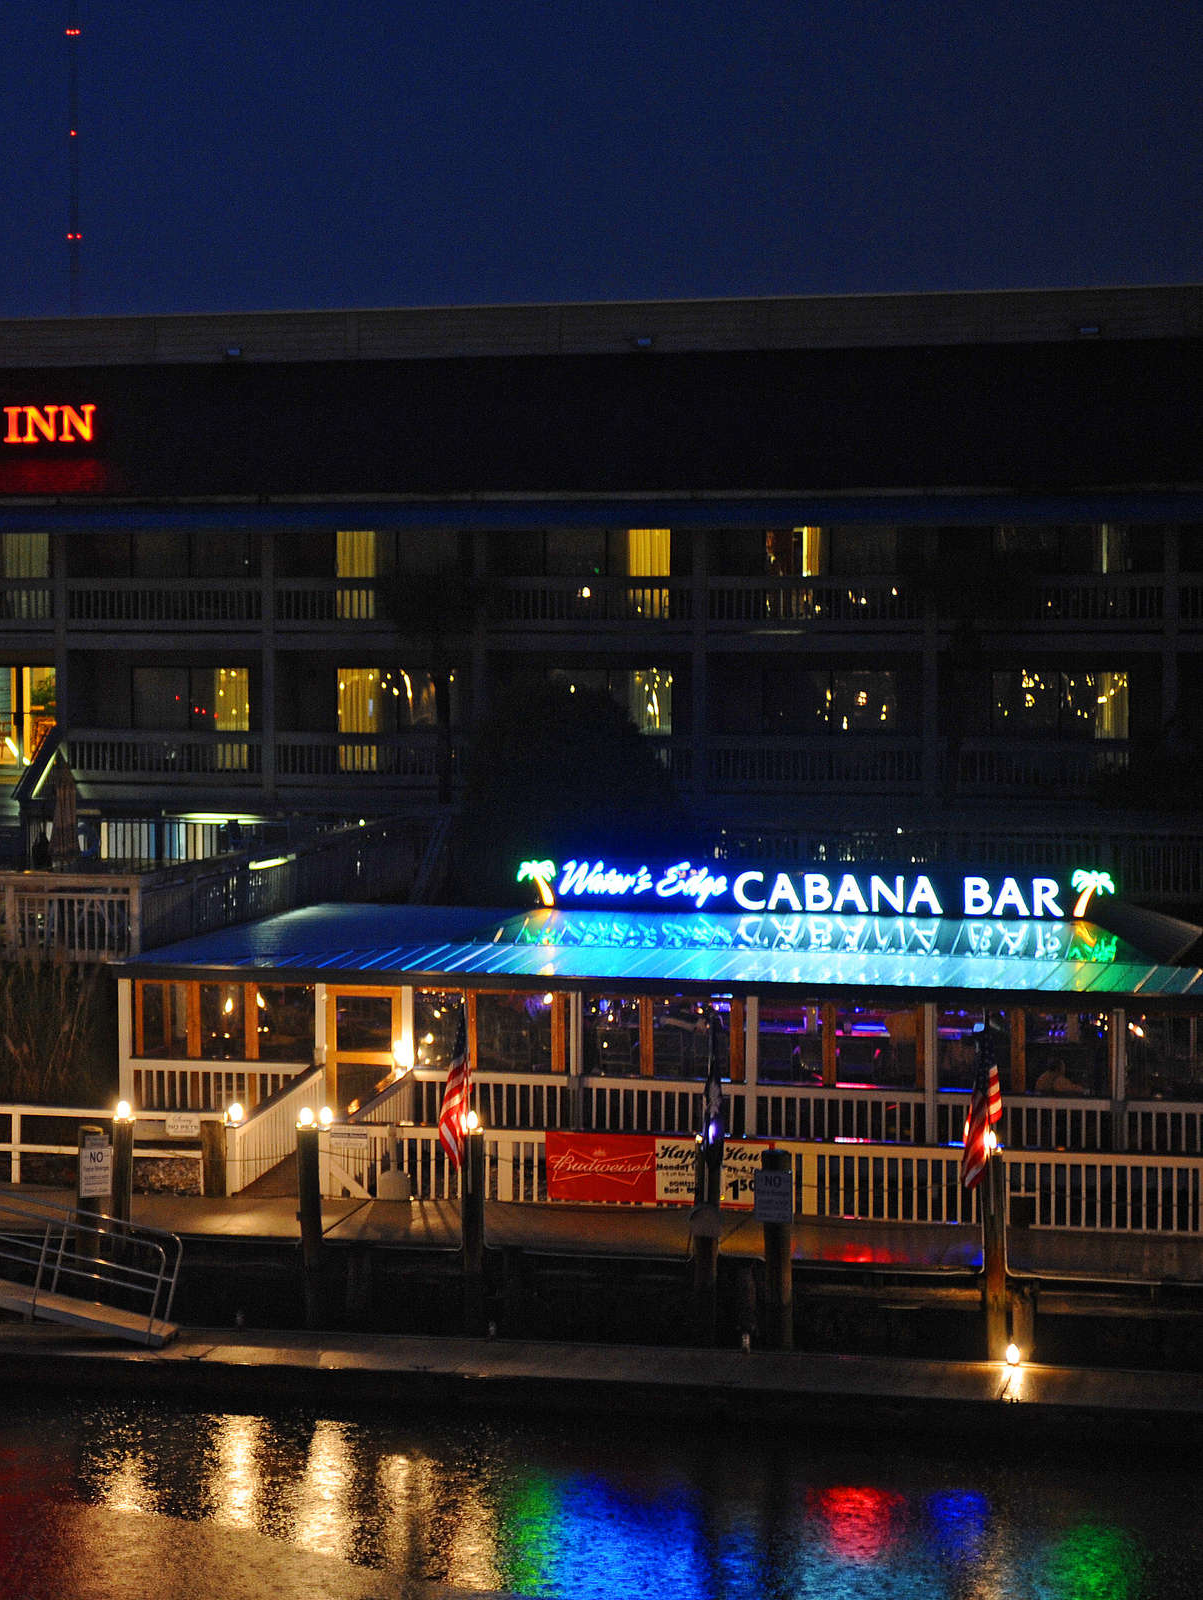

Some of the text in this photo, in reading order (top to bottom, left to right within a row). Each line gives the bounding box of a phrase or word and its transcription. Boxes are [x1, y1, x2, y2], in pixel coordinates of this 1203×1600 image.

[3, 404, 96, 443] INN
[559, 859, 727, 908] Water's Edge
[733, 871, 1064, 917] CABANA BAR
[89, 1151, 104, 1163] NO
[549, 1155, 651, 1173] Budweiser
[656, 1145, 761, 1164] Hap Hou
[764, 1175, 782, 1188] NO
